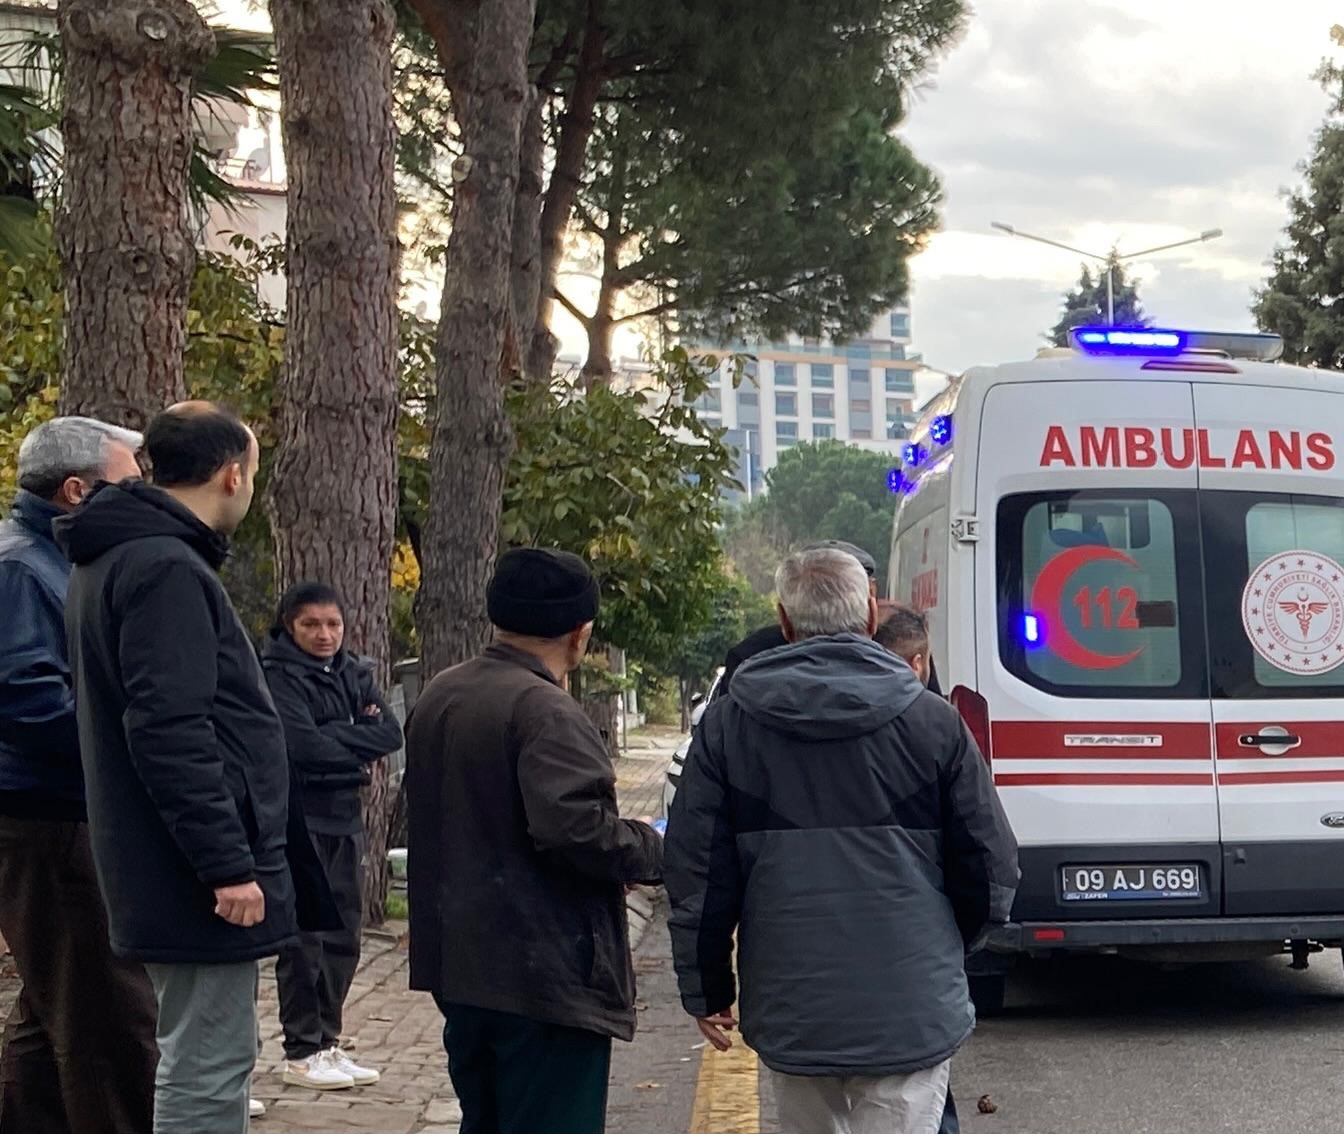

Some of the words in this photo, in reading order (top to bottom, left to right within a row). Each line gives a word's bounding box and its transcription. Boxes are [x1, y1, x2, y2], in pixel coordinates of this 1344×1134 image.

[1039, 425, 1336, 471] AMBULANS
[1072, 586, 1140, 629] 112
[1065, 735, 1161, 745] TRANSIT
[1075, 869, 1105, 891] 09
[1113, 869, 1145, 890] AJ
[1152, 868, 1194, 890] 669
